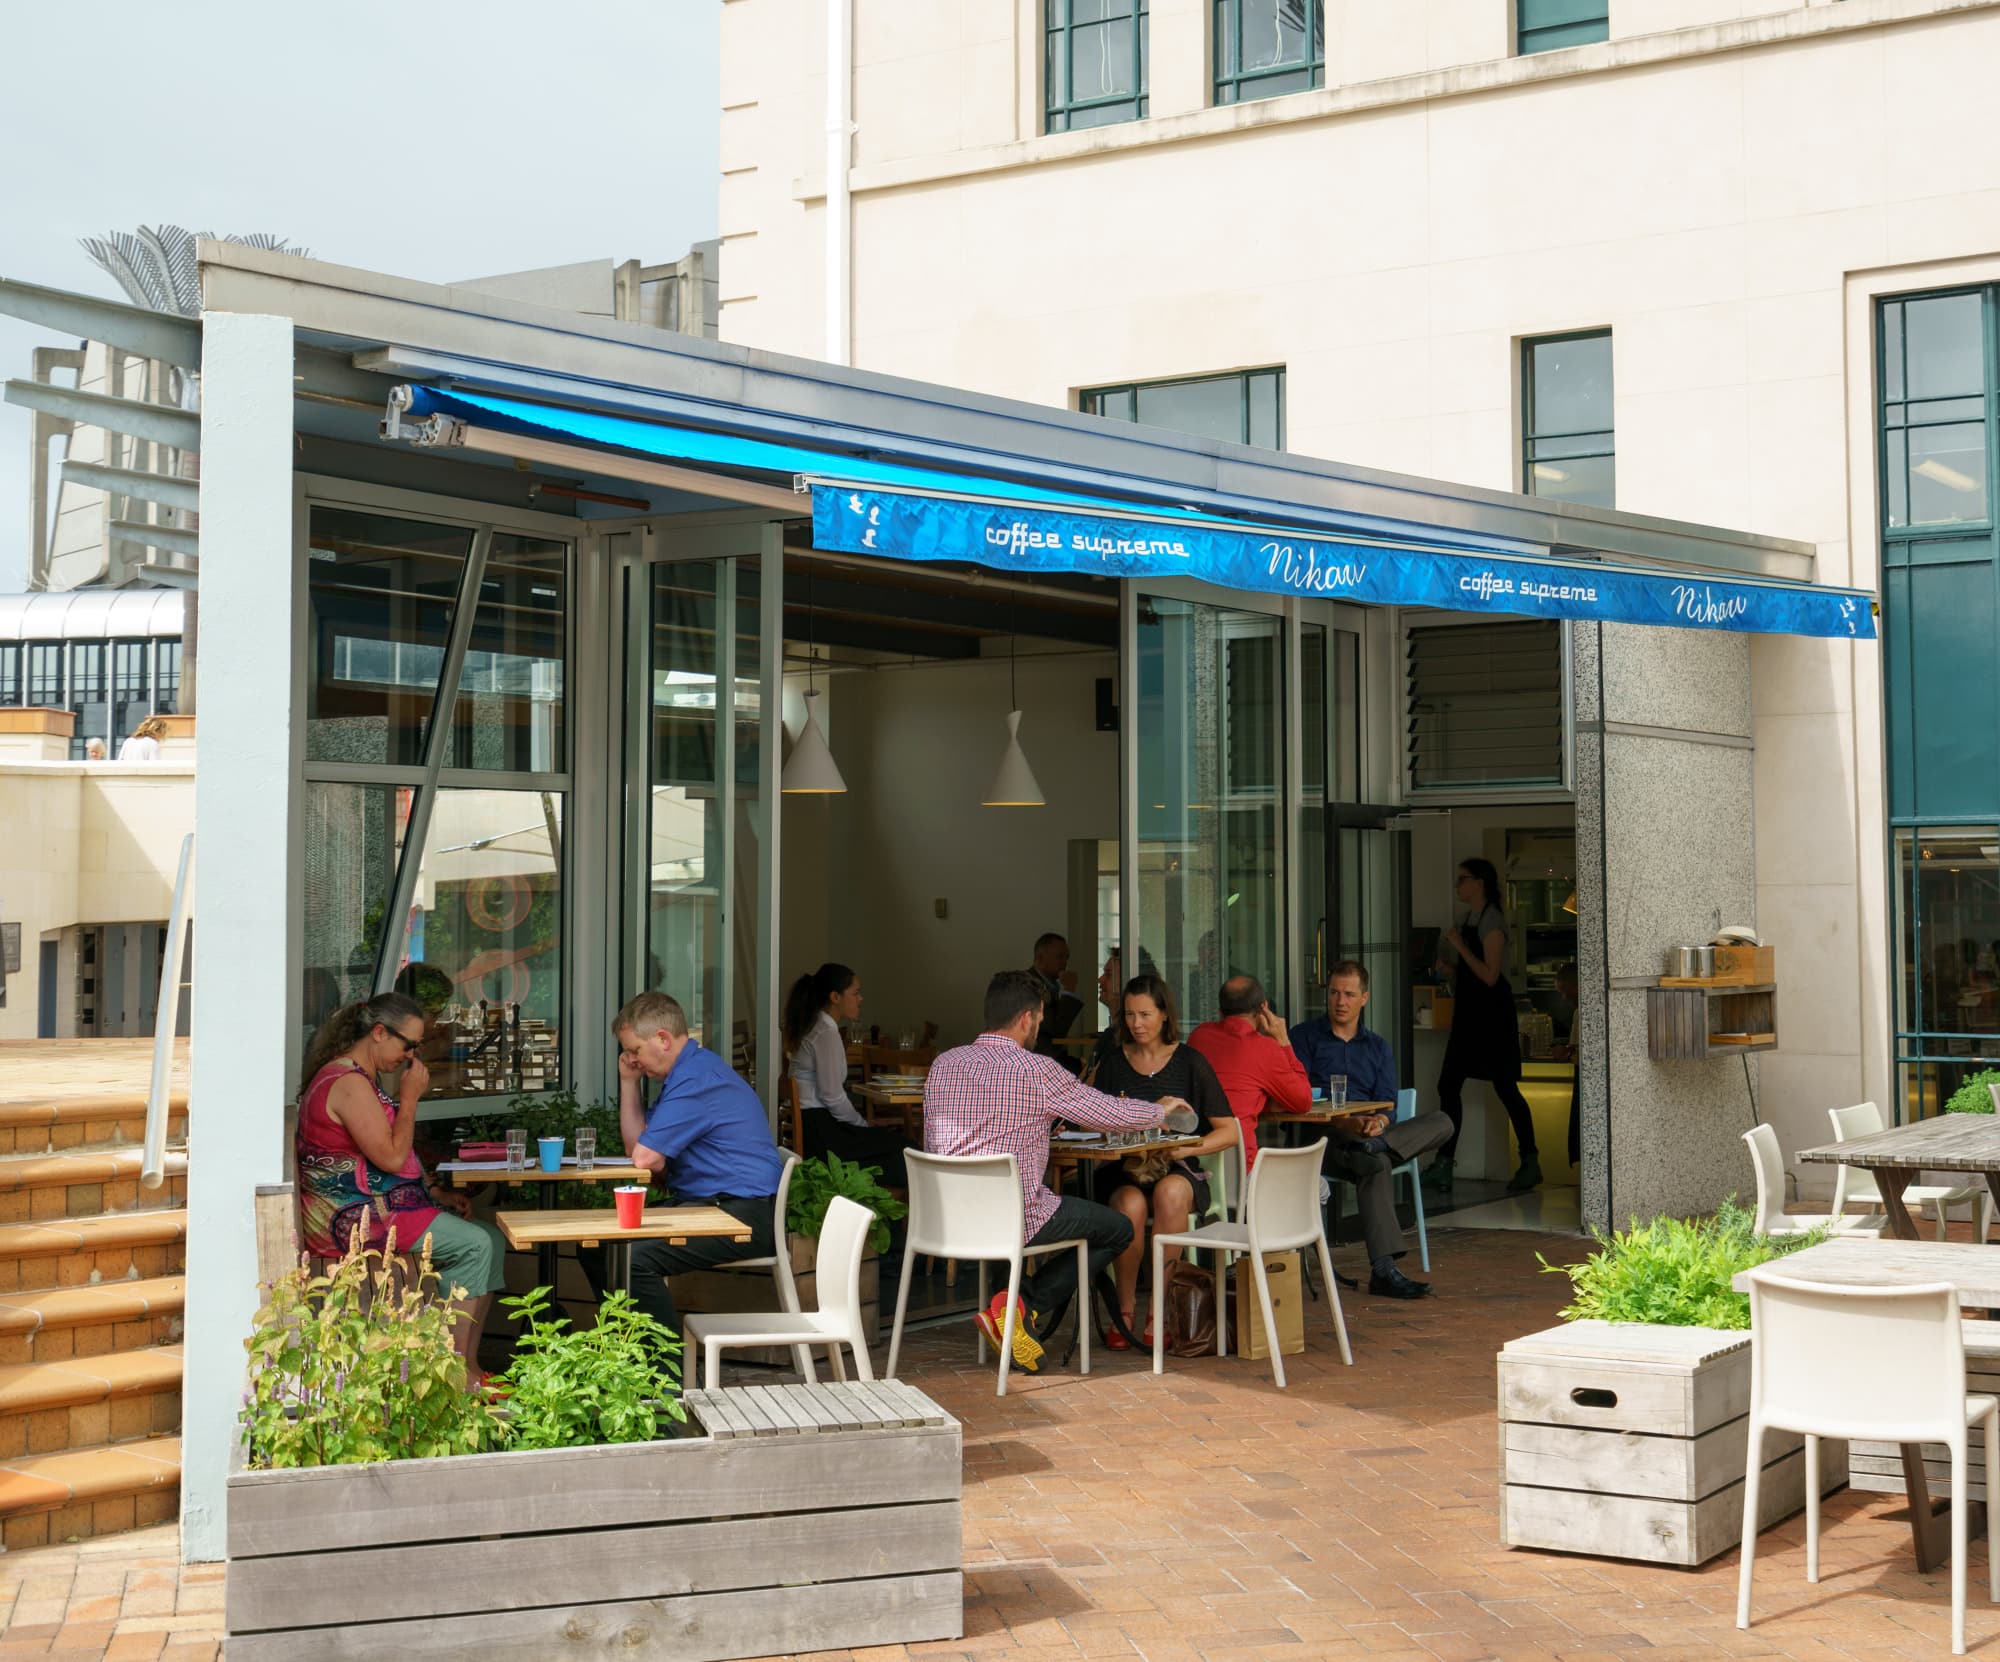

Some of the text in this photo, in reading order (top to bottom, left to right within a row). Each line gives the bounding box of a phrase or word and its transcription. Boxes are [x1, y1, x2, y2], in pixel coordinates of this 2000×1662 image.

[985, 522, 1190, 560] coffee supreme
[1260, 542, 1367, 592] Nikau
[1459, 572, 1598, 603] coffee supreme
[1670, 585, 1747, 623] Nikau
